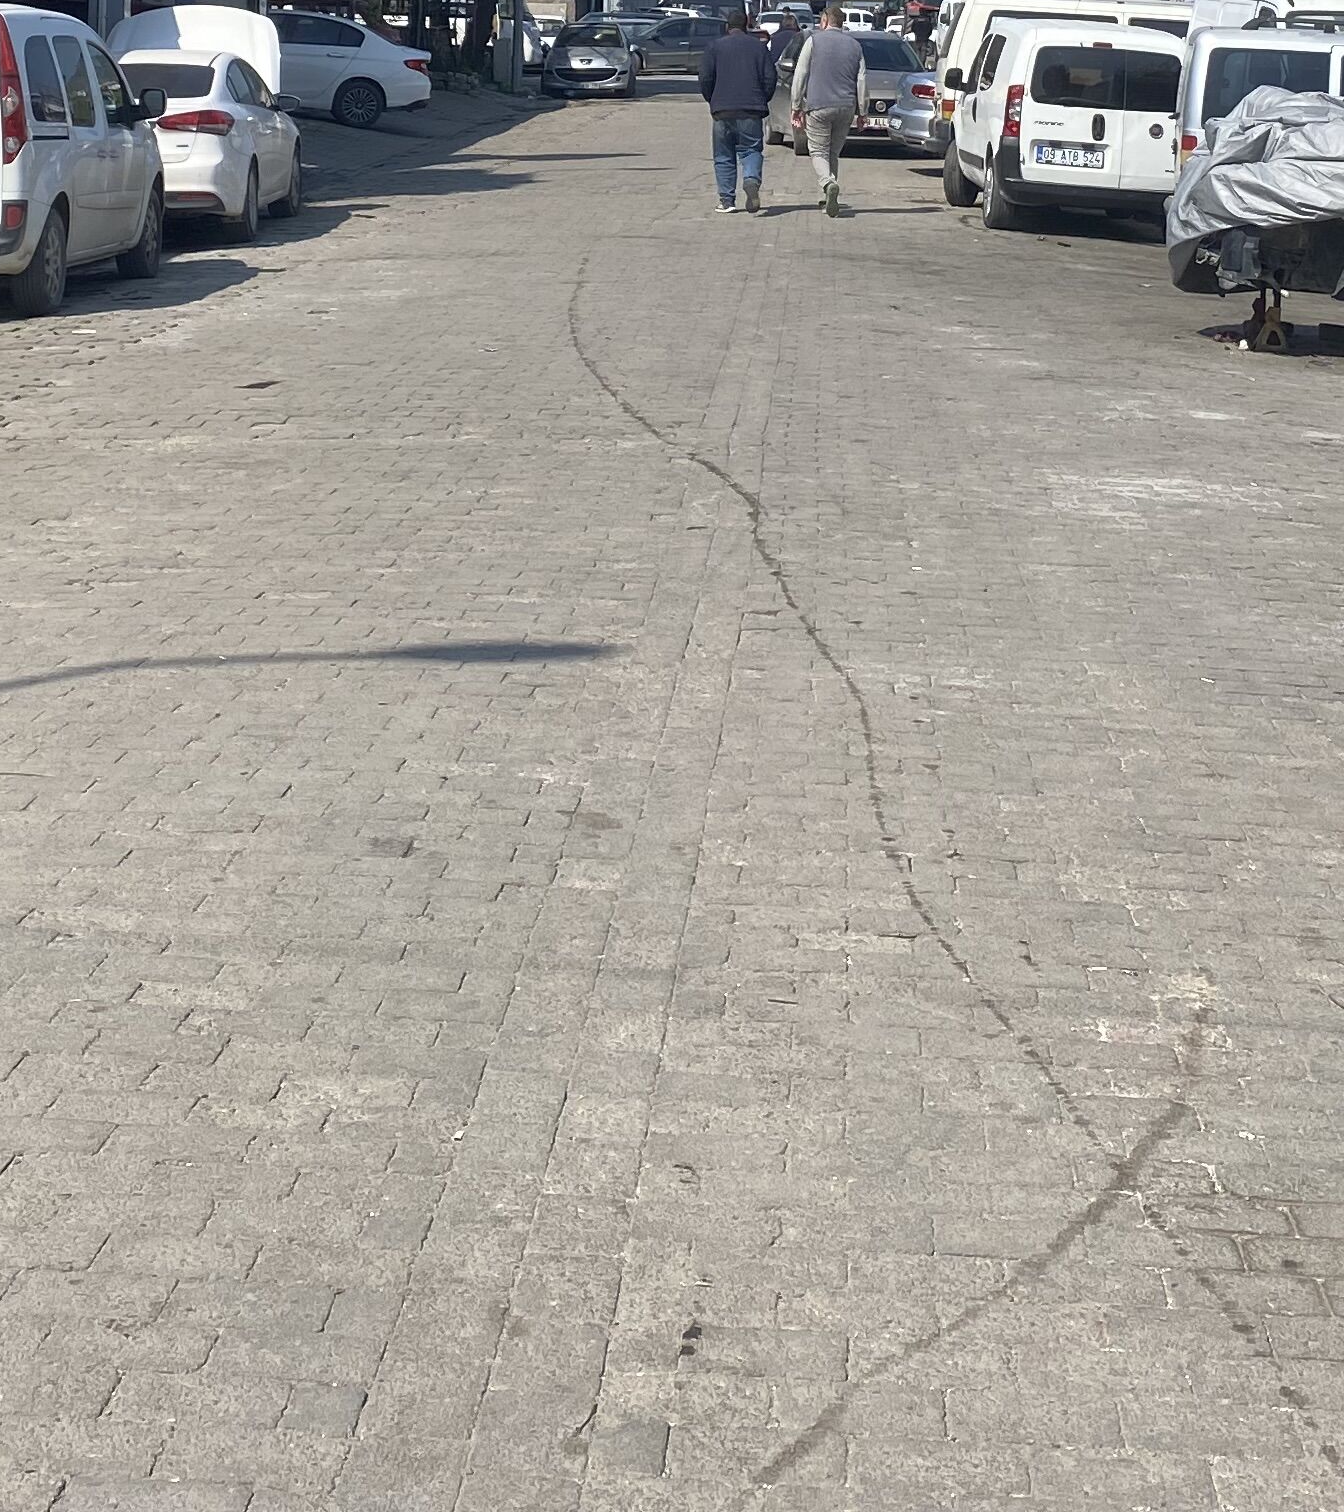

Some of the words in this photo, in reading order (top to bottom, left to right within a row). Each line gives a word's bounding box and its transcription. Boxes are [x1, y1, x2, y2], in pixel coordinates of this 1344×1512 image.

[1043, 149, 1056, 160] 09
[1060, 150, 1079, 162] ATB
[1083, 151, 1101, 164] 524
